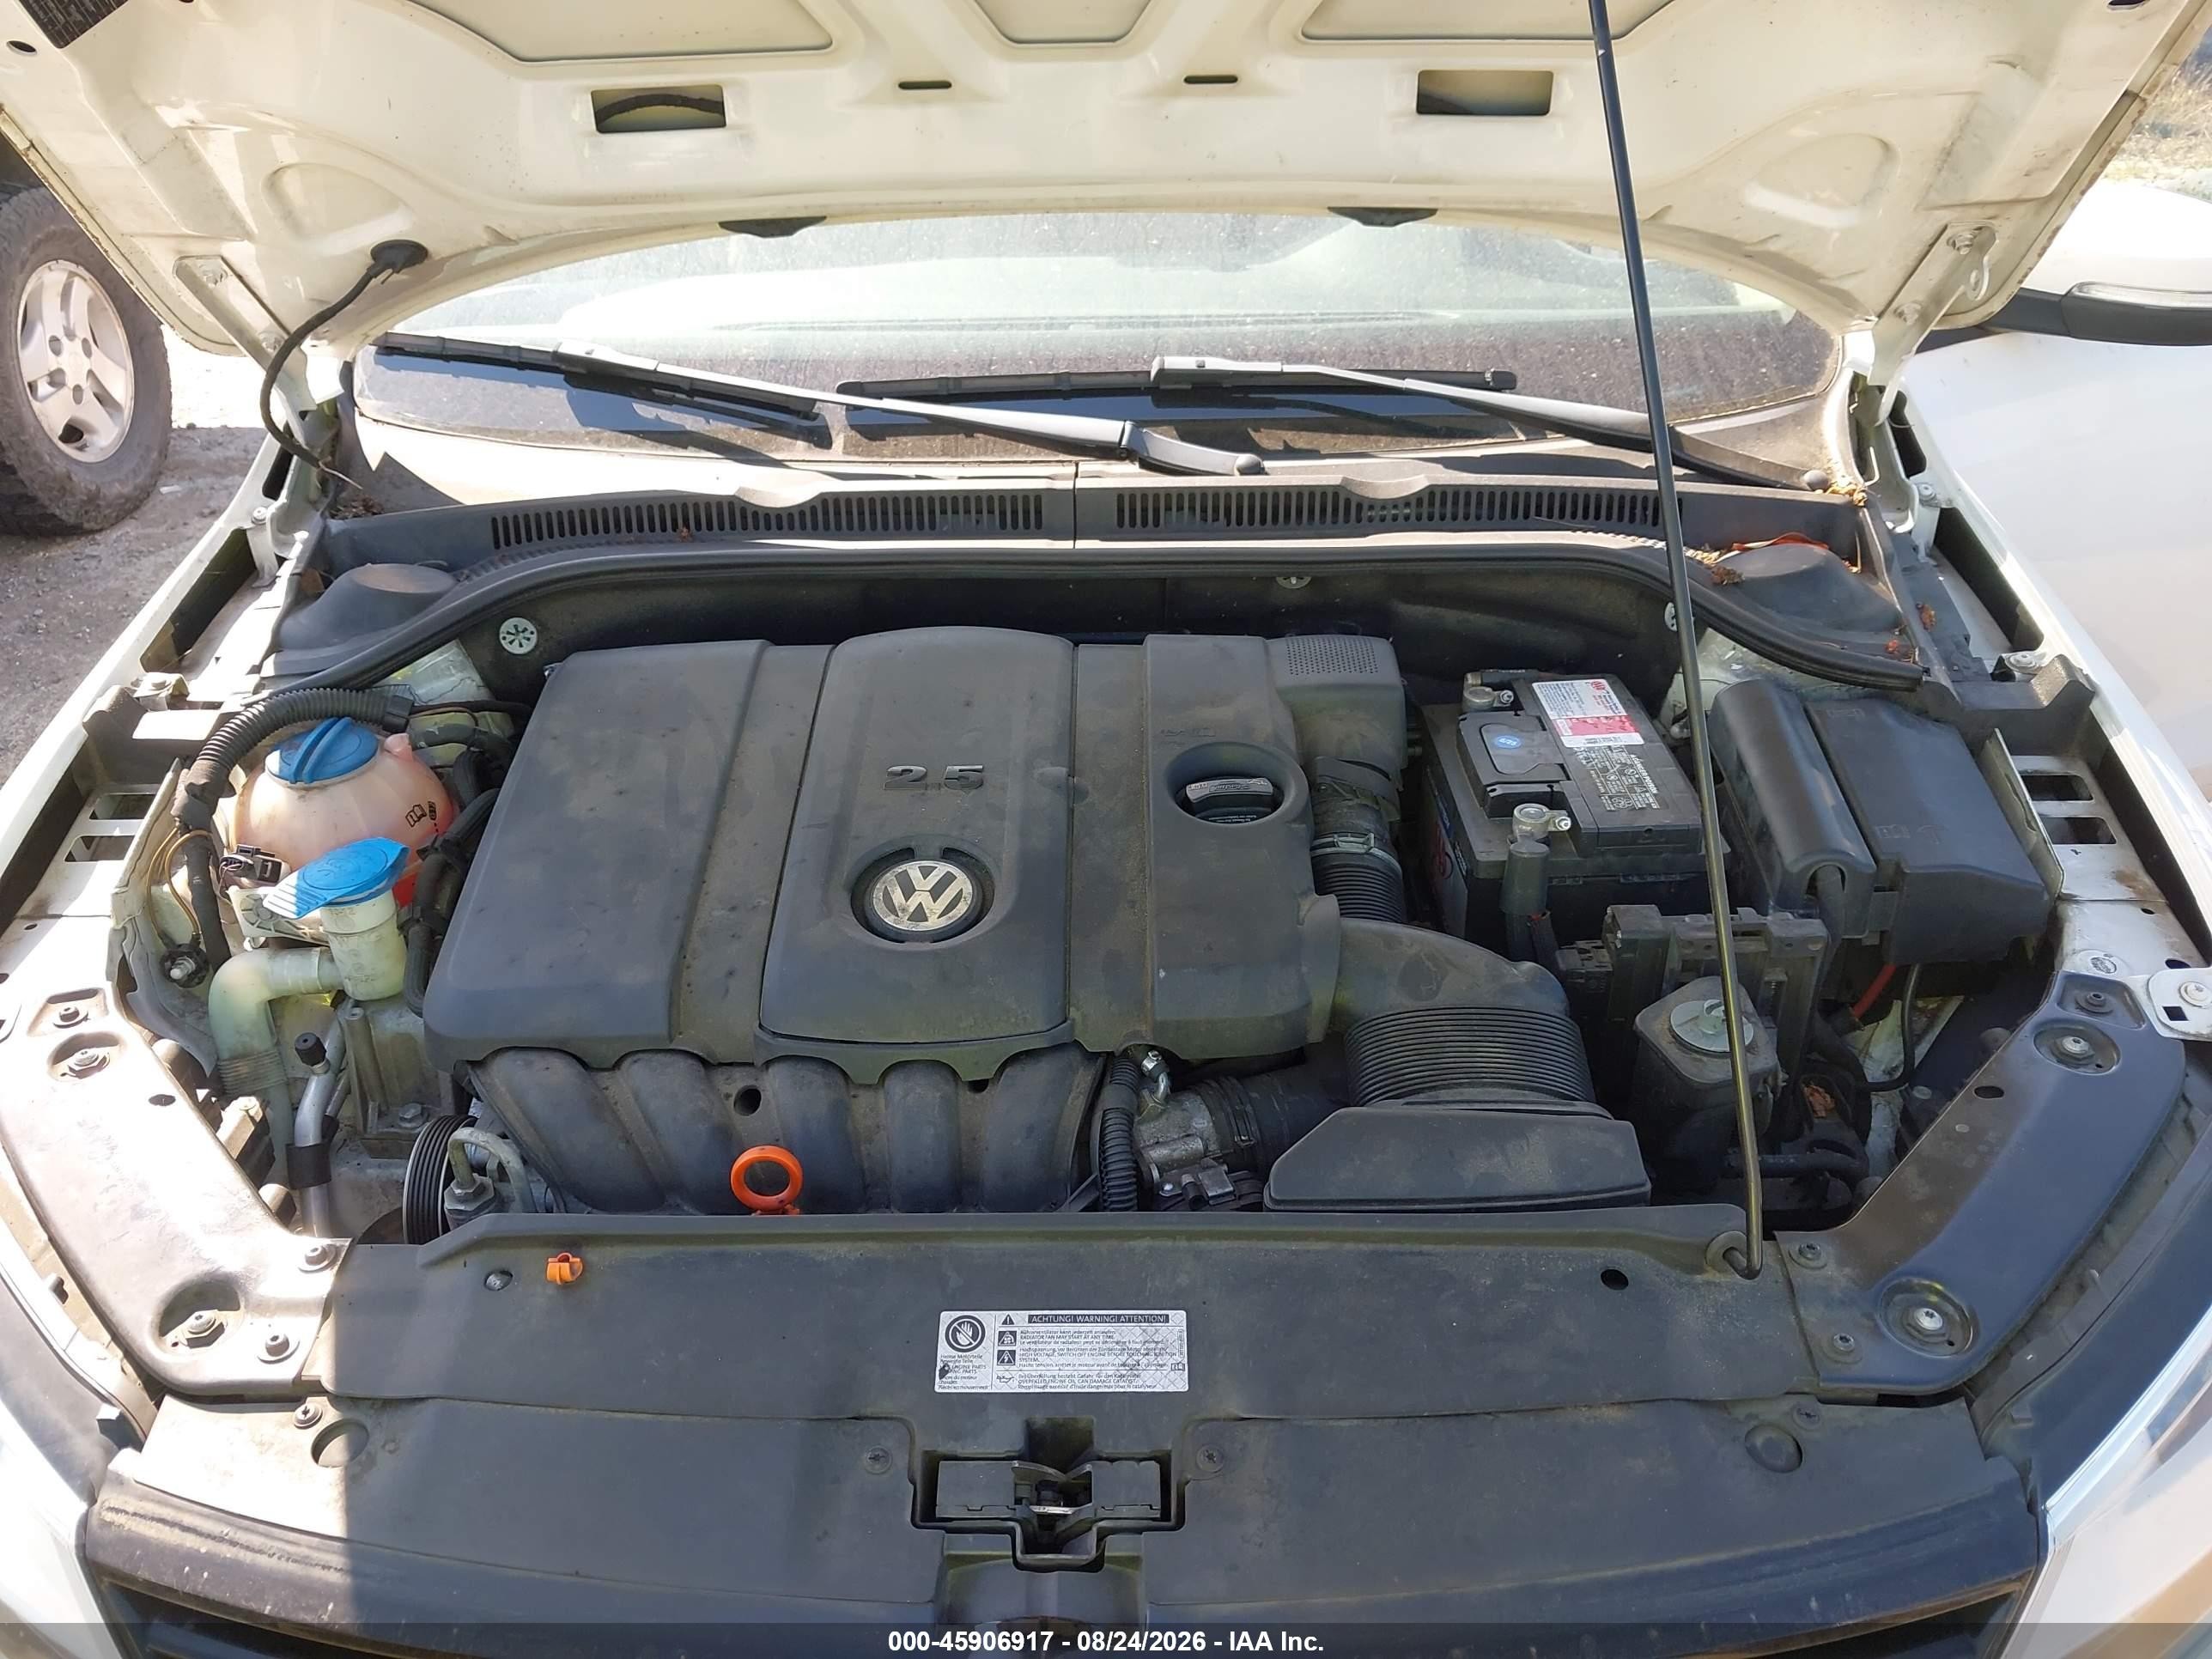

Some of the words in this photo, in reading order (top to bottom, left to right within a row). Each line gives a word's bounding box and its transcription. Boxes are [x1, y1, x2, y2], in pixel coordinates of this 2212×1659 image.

[1031, 1315, 1073, 1323] ACHTUNG!
[1076, 1315, 1117, 1323] WARNING!
[1120, 1315, 1166, 1323] ATTENTION!
